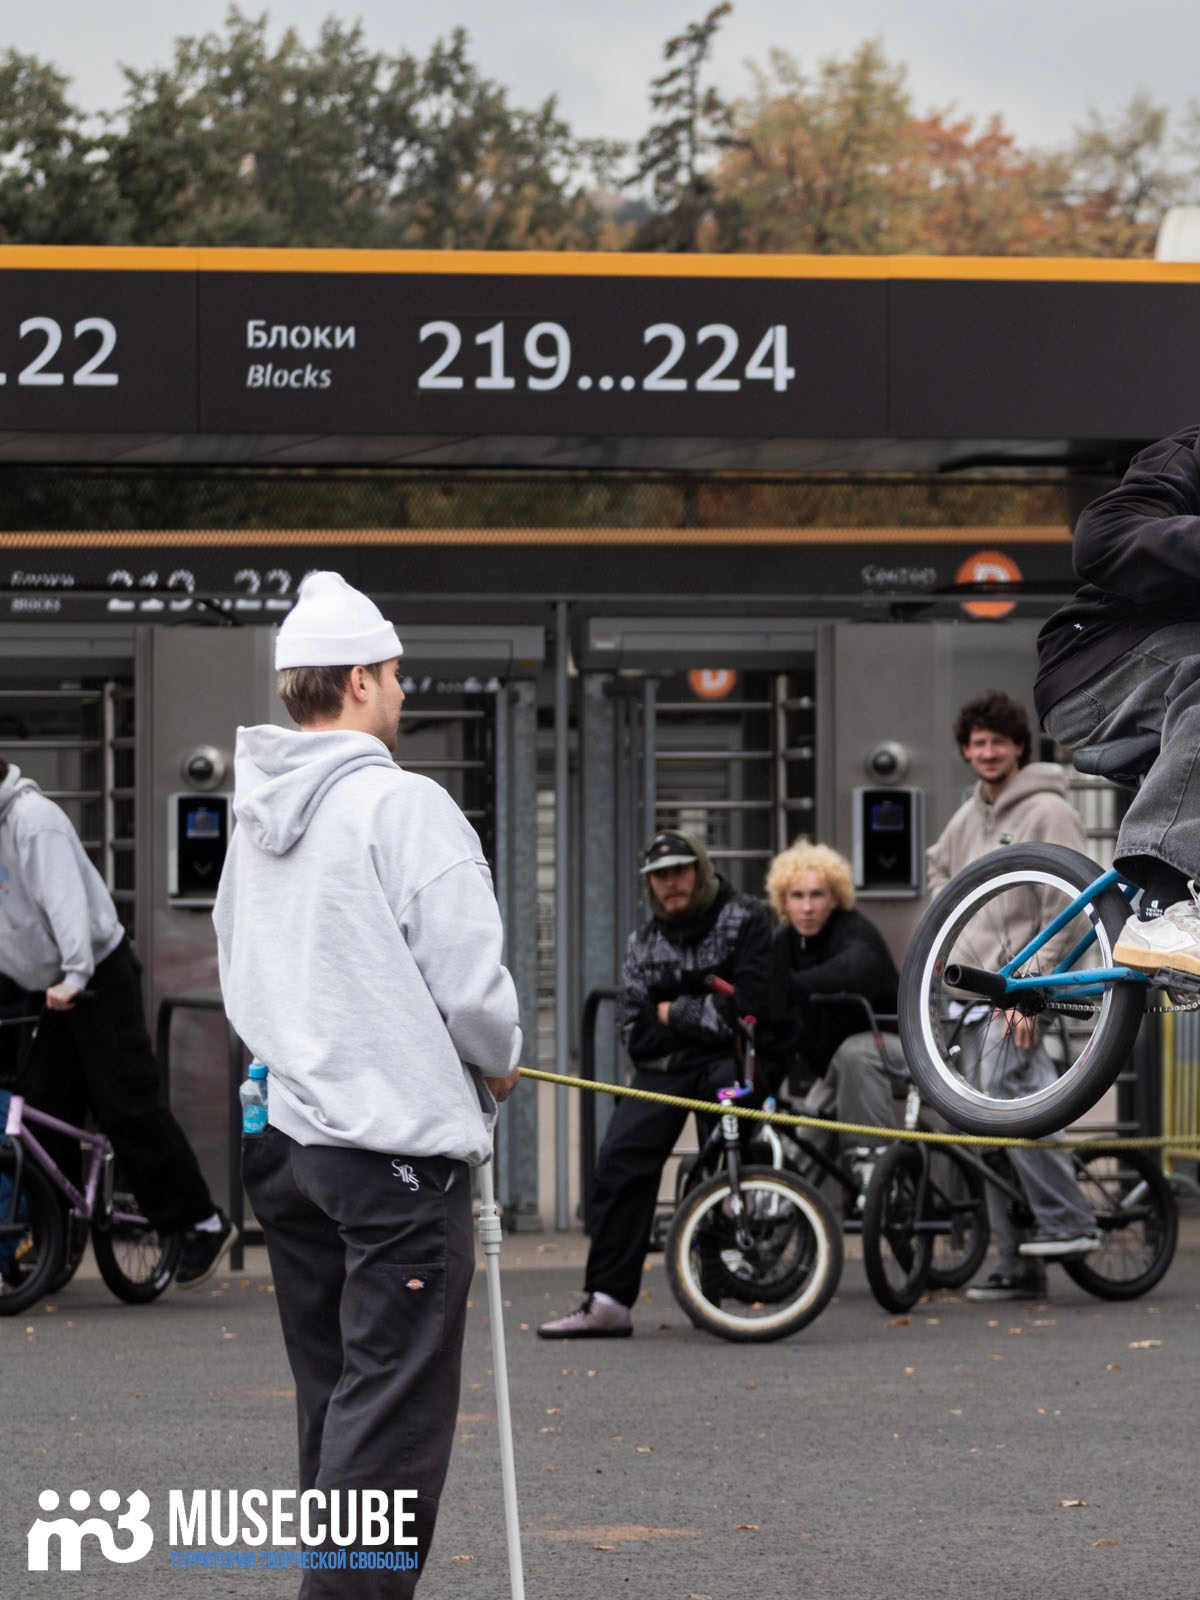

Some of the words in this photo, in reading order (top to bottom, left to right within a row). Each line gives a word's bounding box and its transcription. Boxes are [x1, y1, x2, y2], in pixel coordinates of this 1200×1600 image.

[247, 320, 355, 348] Блоки
[418, 320, 795, 392] 219...224
[246, 363, 332, 388] Blocks
